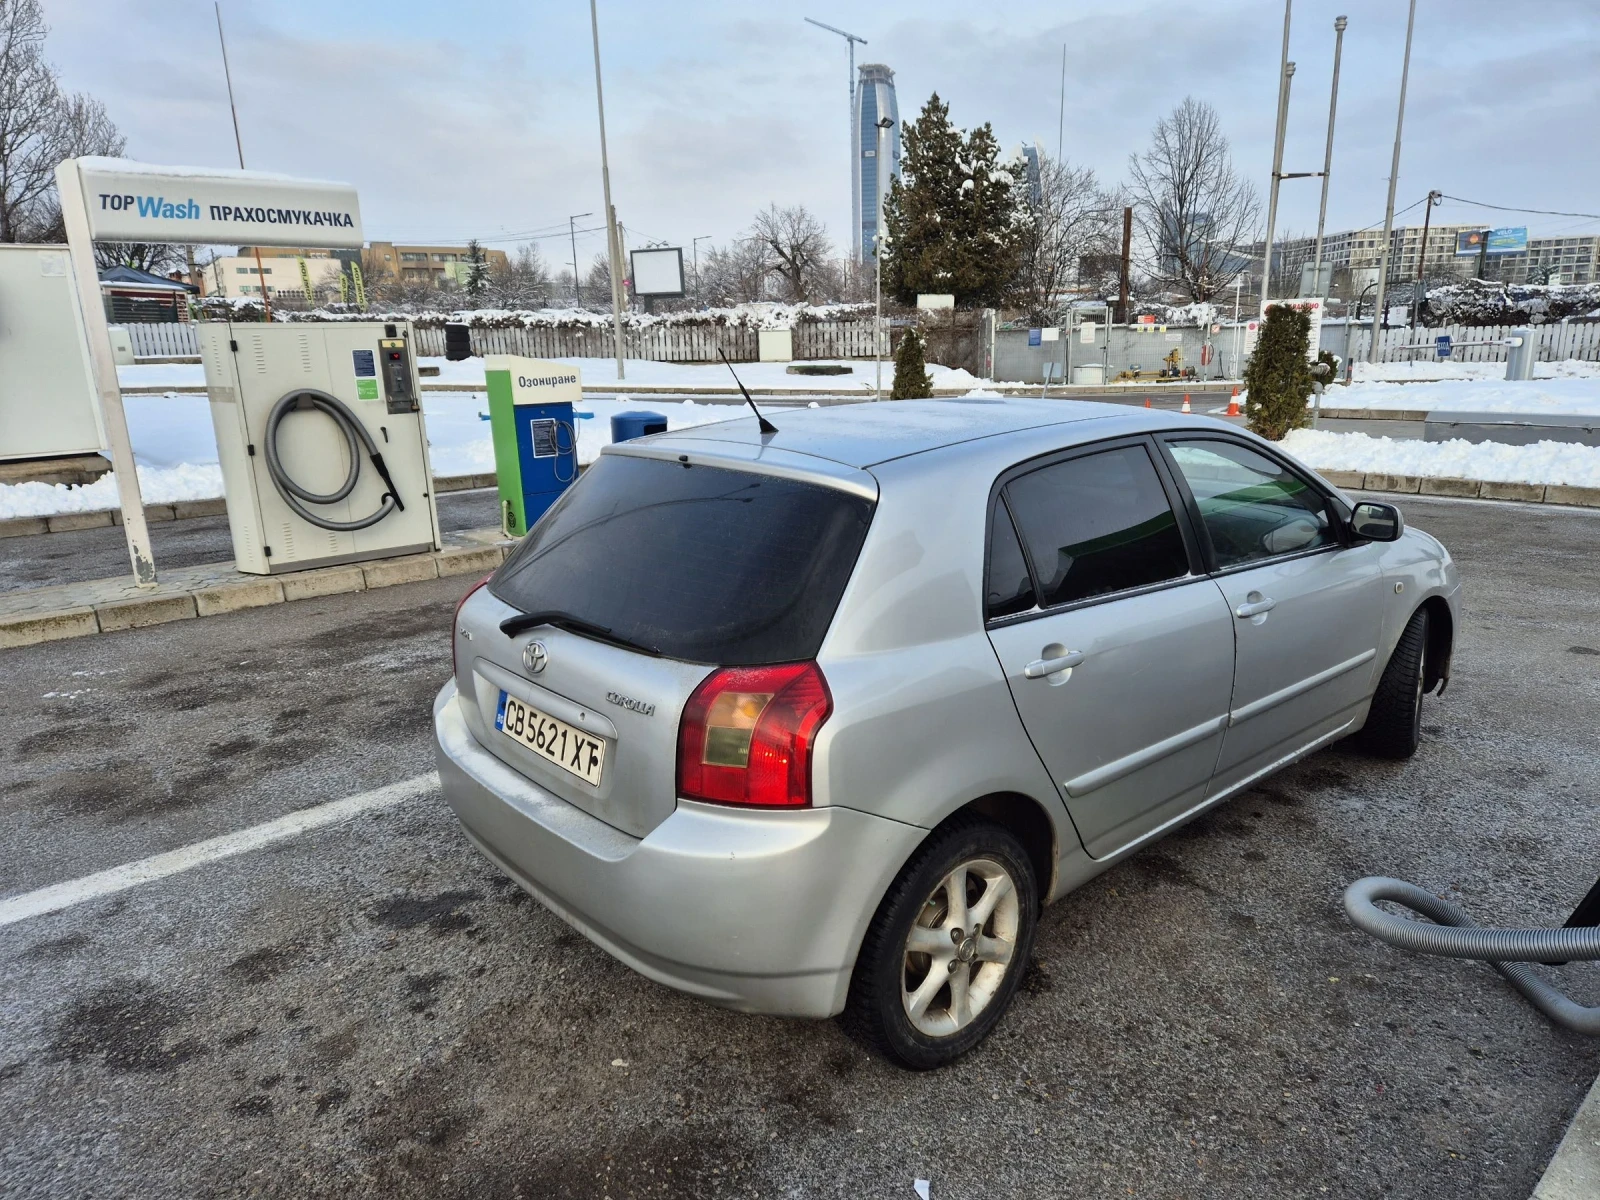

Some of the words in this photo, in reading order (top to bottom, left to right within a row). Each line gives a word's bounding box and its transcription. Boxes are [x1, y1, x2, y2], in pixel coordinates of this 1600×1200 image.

[98, 194, 135, 211] TOP
[136, 196, 200, 220] Wash
[209, 205, 355, 228] ПРАХОСМУКАЧКА
[518, 375, 577, 388] Озониране
[606, 691, 656, 717] COROLLA
[526, 710, 568, 762] 5621
